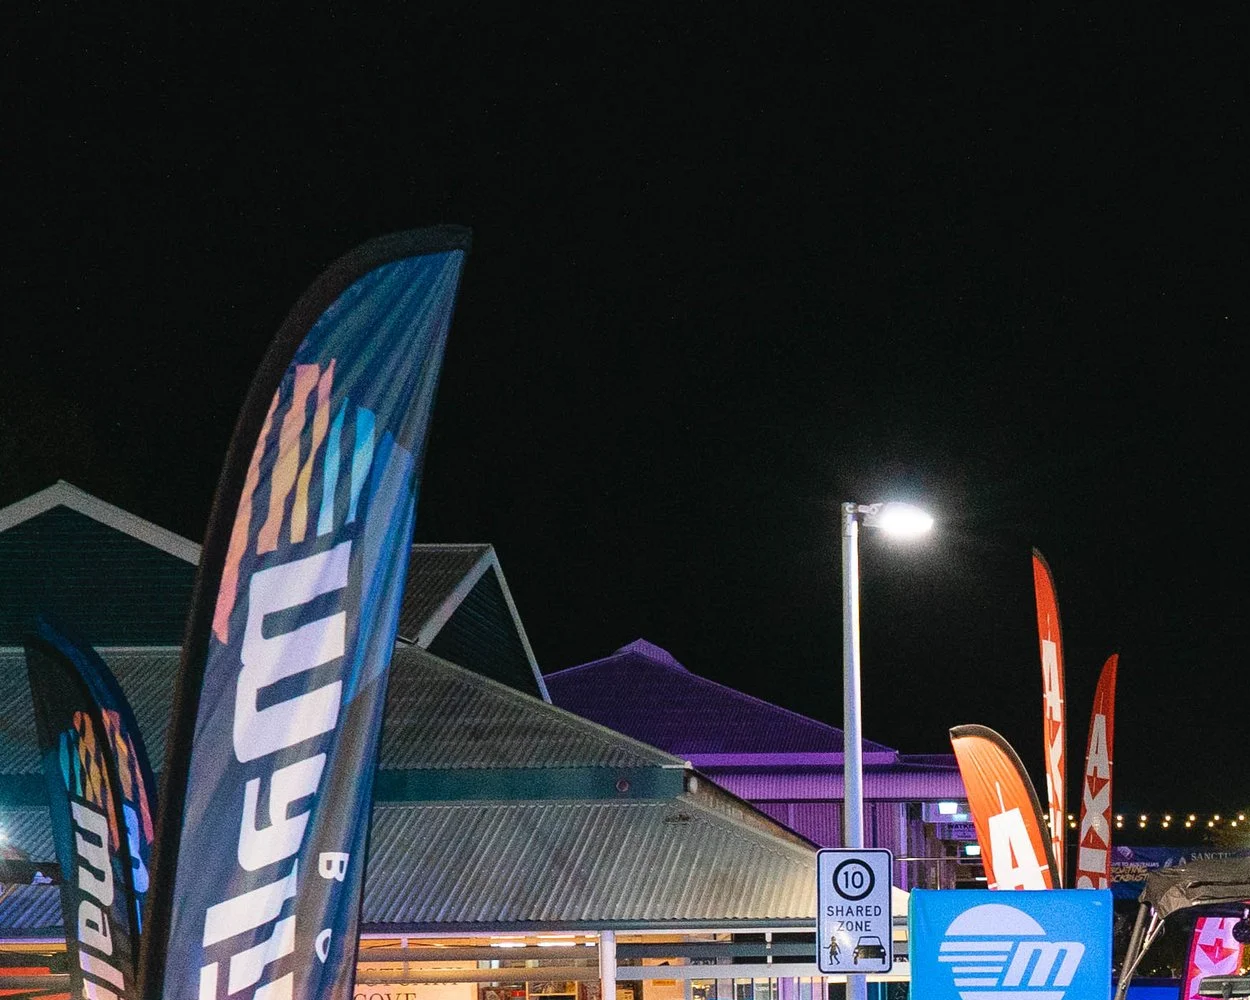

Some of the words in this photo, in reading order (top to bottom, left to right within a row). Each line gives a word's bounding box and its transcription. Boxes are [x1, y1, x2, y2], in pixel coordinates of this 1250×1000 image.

[843, 871, 864, 889] 10
[827, 905, 882, 917] SHARED
[837, 920, 872, 932] ZONE
